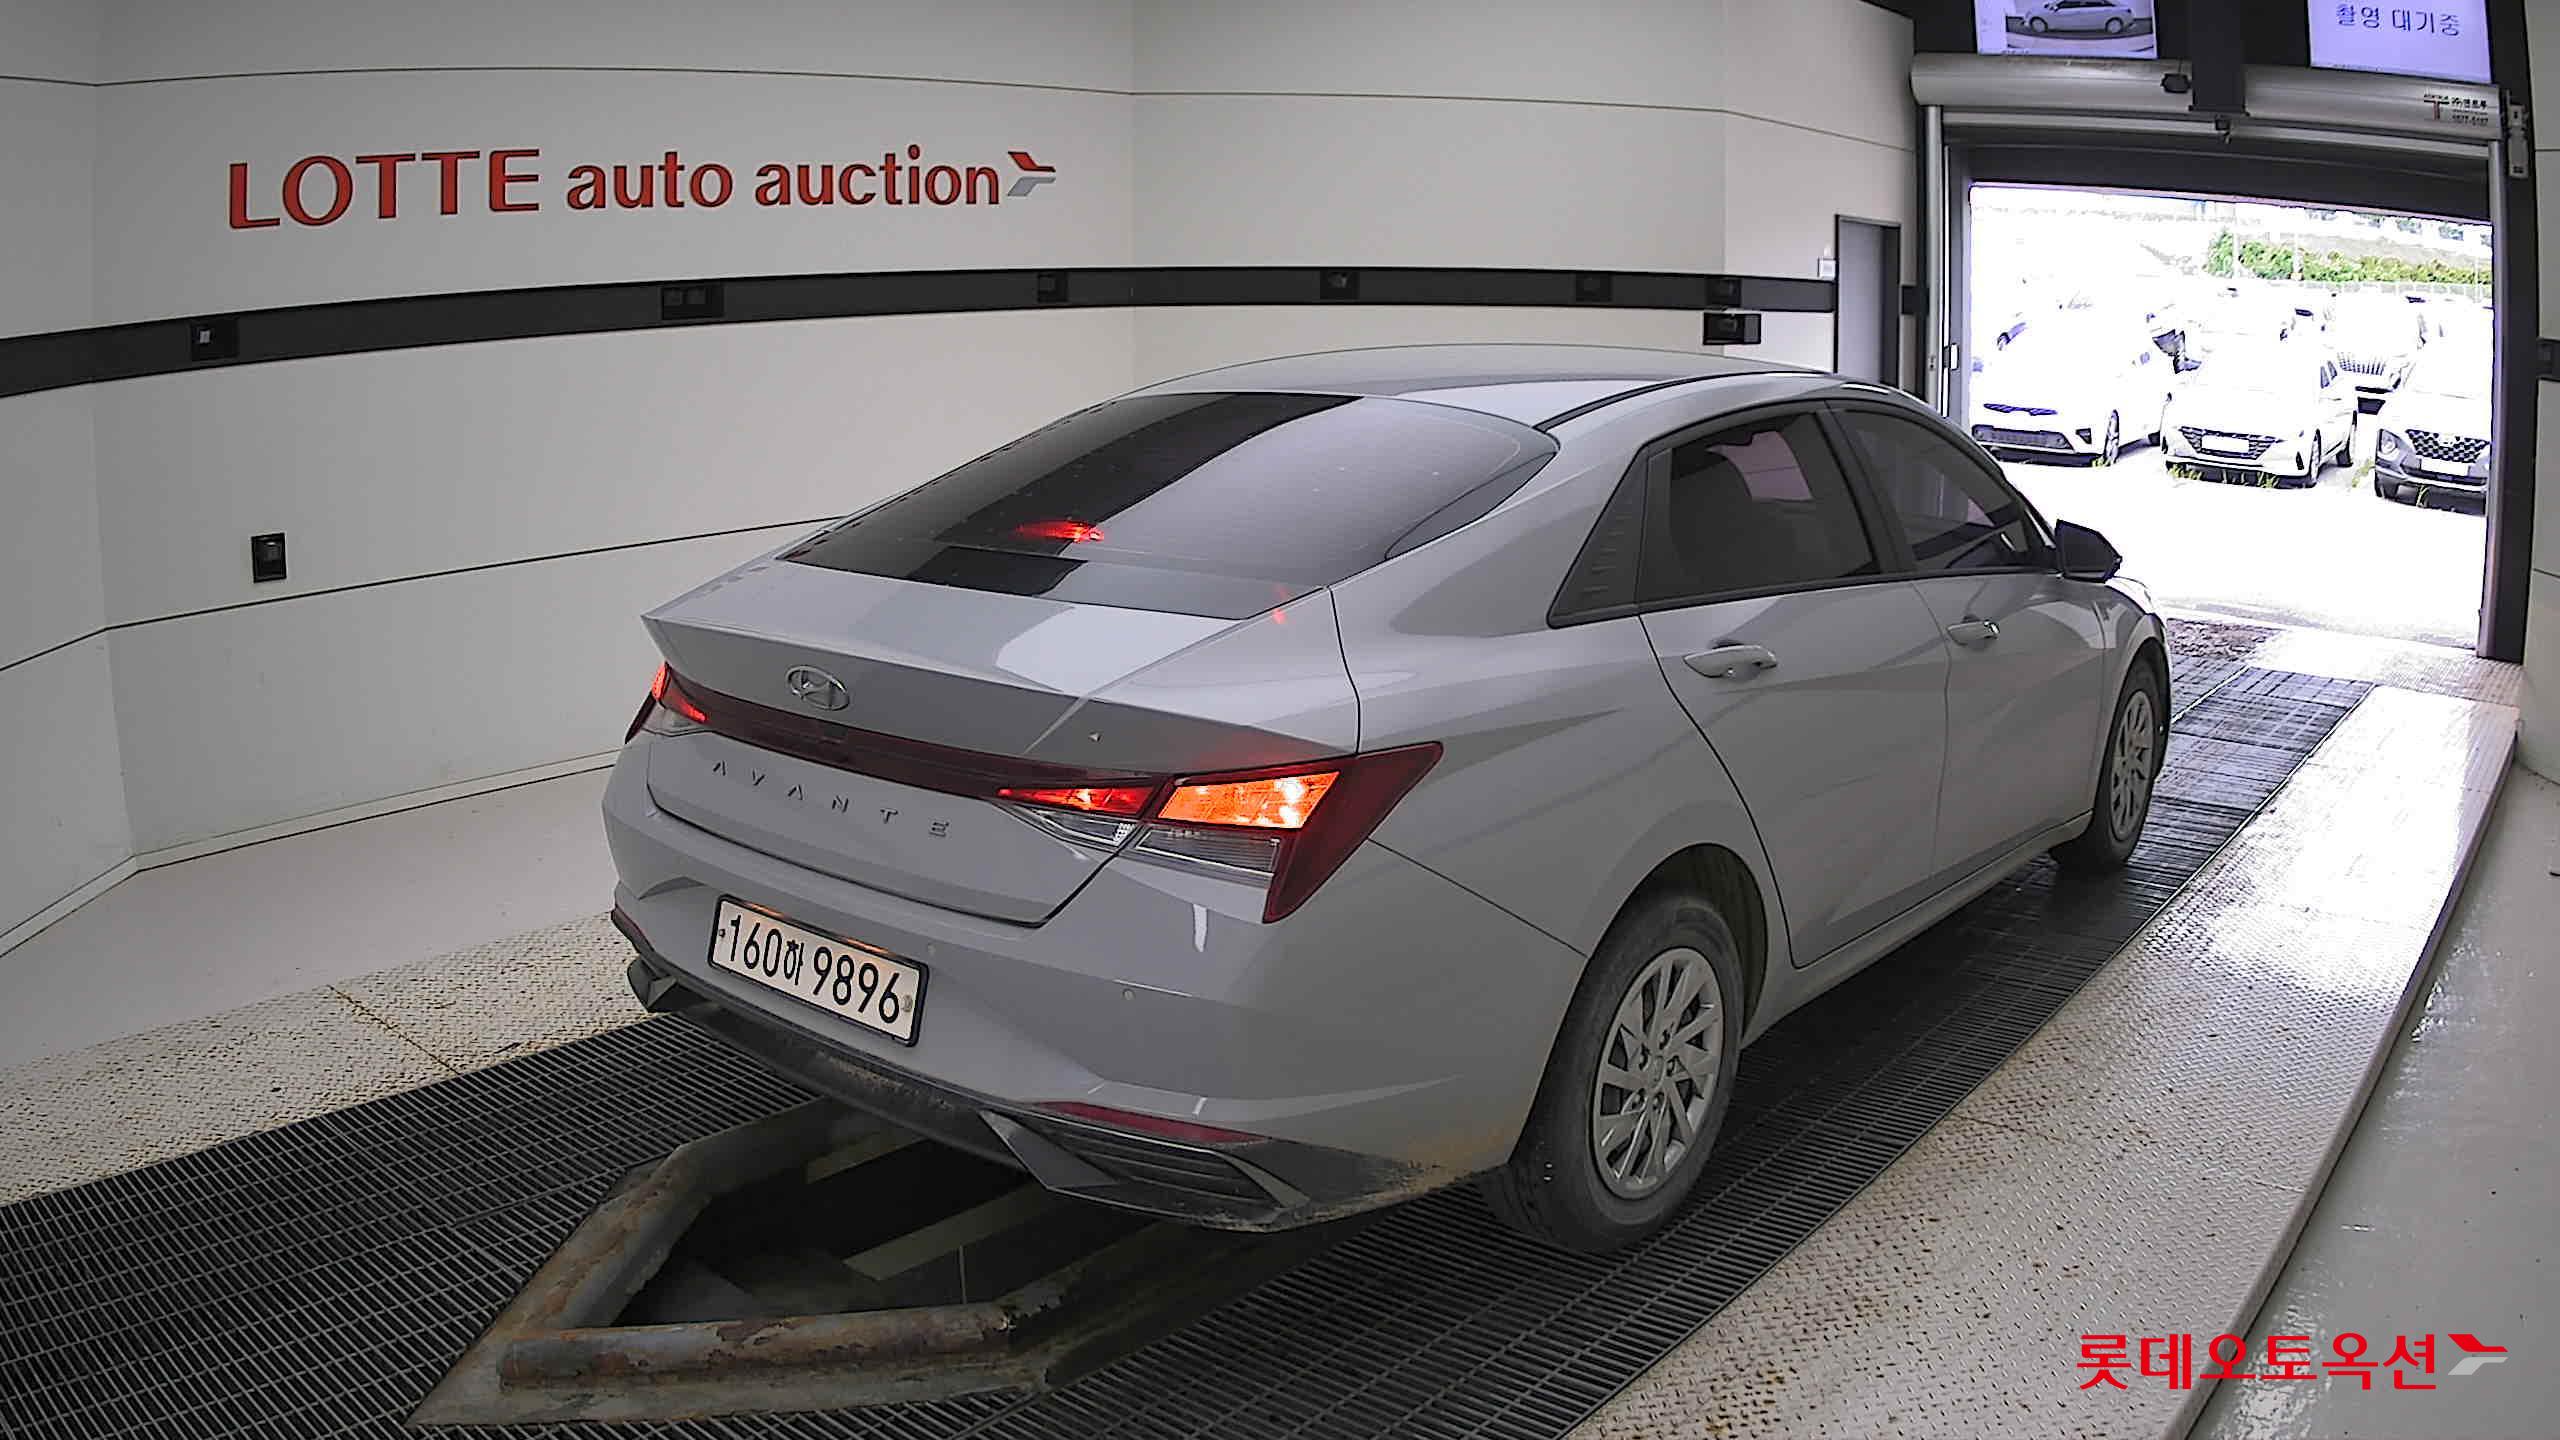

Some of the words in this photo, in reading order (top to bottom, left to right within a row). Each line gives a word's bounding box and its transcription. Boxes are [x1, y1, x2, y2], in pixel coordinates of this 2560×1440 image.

[2391, 8, 2460, 37] 대기중
[228, 148, 541, 230] LOTTE
[565, 150, 735, 211] auto
[754, 144, 1001, 209] auction
[711, 760, 951, 838] AVANTE
